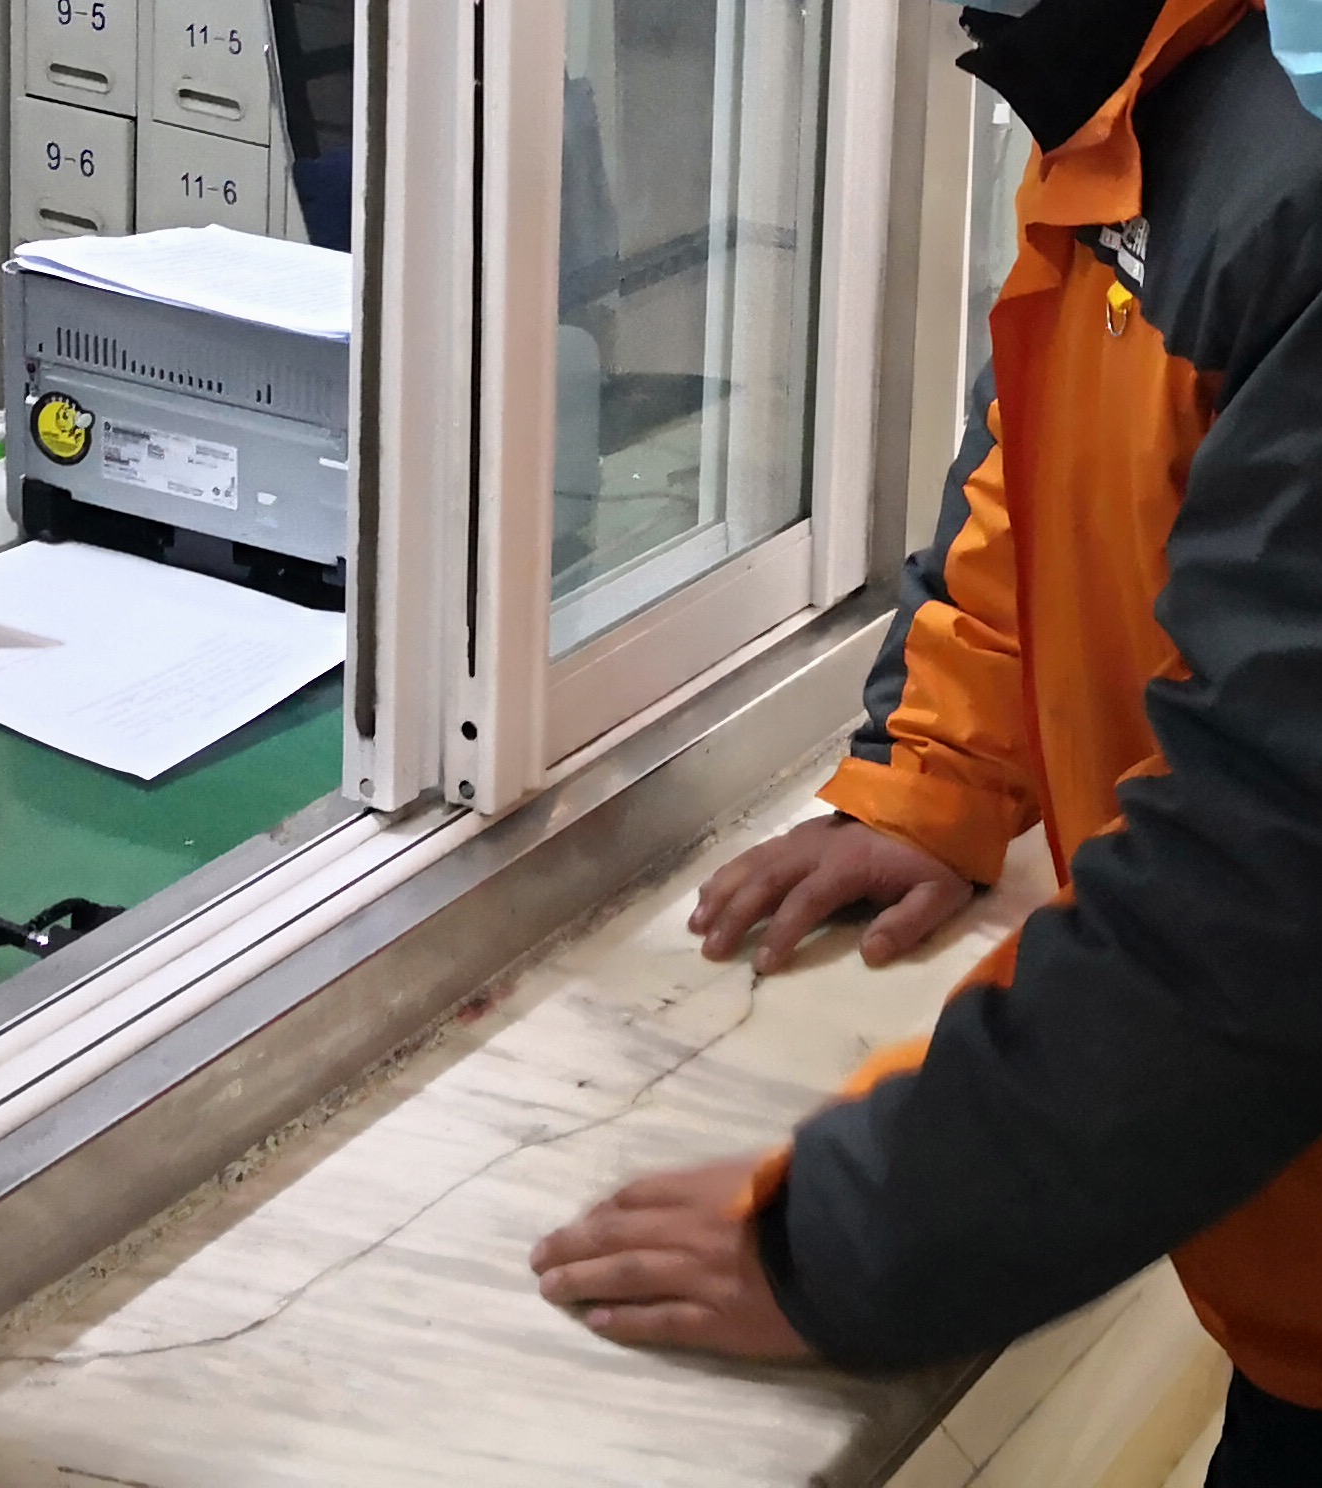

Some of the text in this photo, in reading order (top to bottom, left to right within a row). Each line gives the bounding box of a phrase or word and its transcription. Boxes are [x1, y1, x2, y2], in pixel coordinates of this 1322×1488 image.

[185, 23, 243, 56] 11-5
[46, 141, 95, 178] 9-6
[180, 172, 237, 205] 11-6
